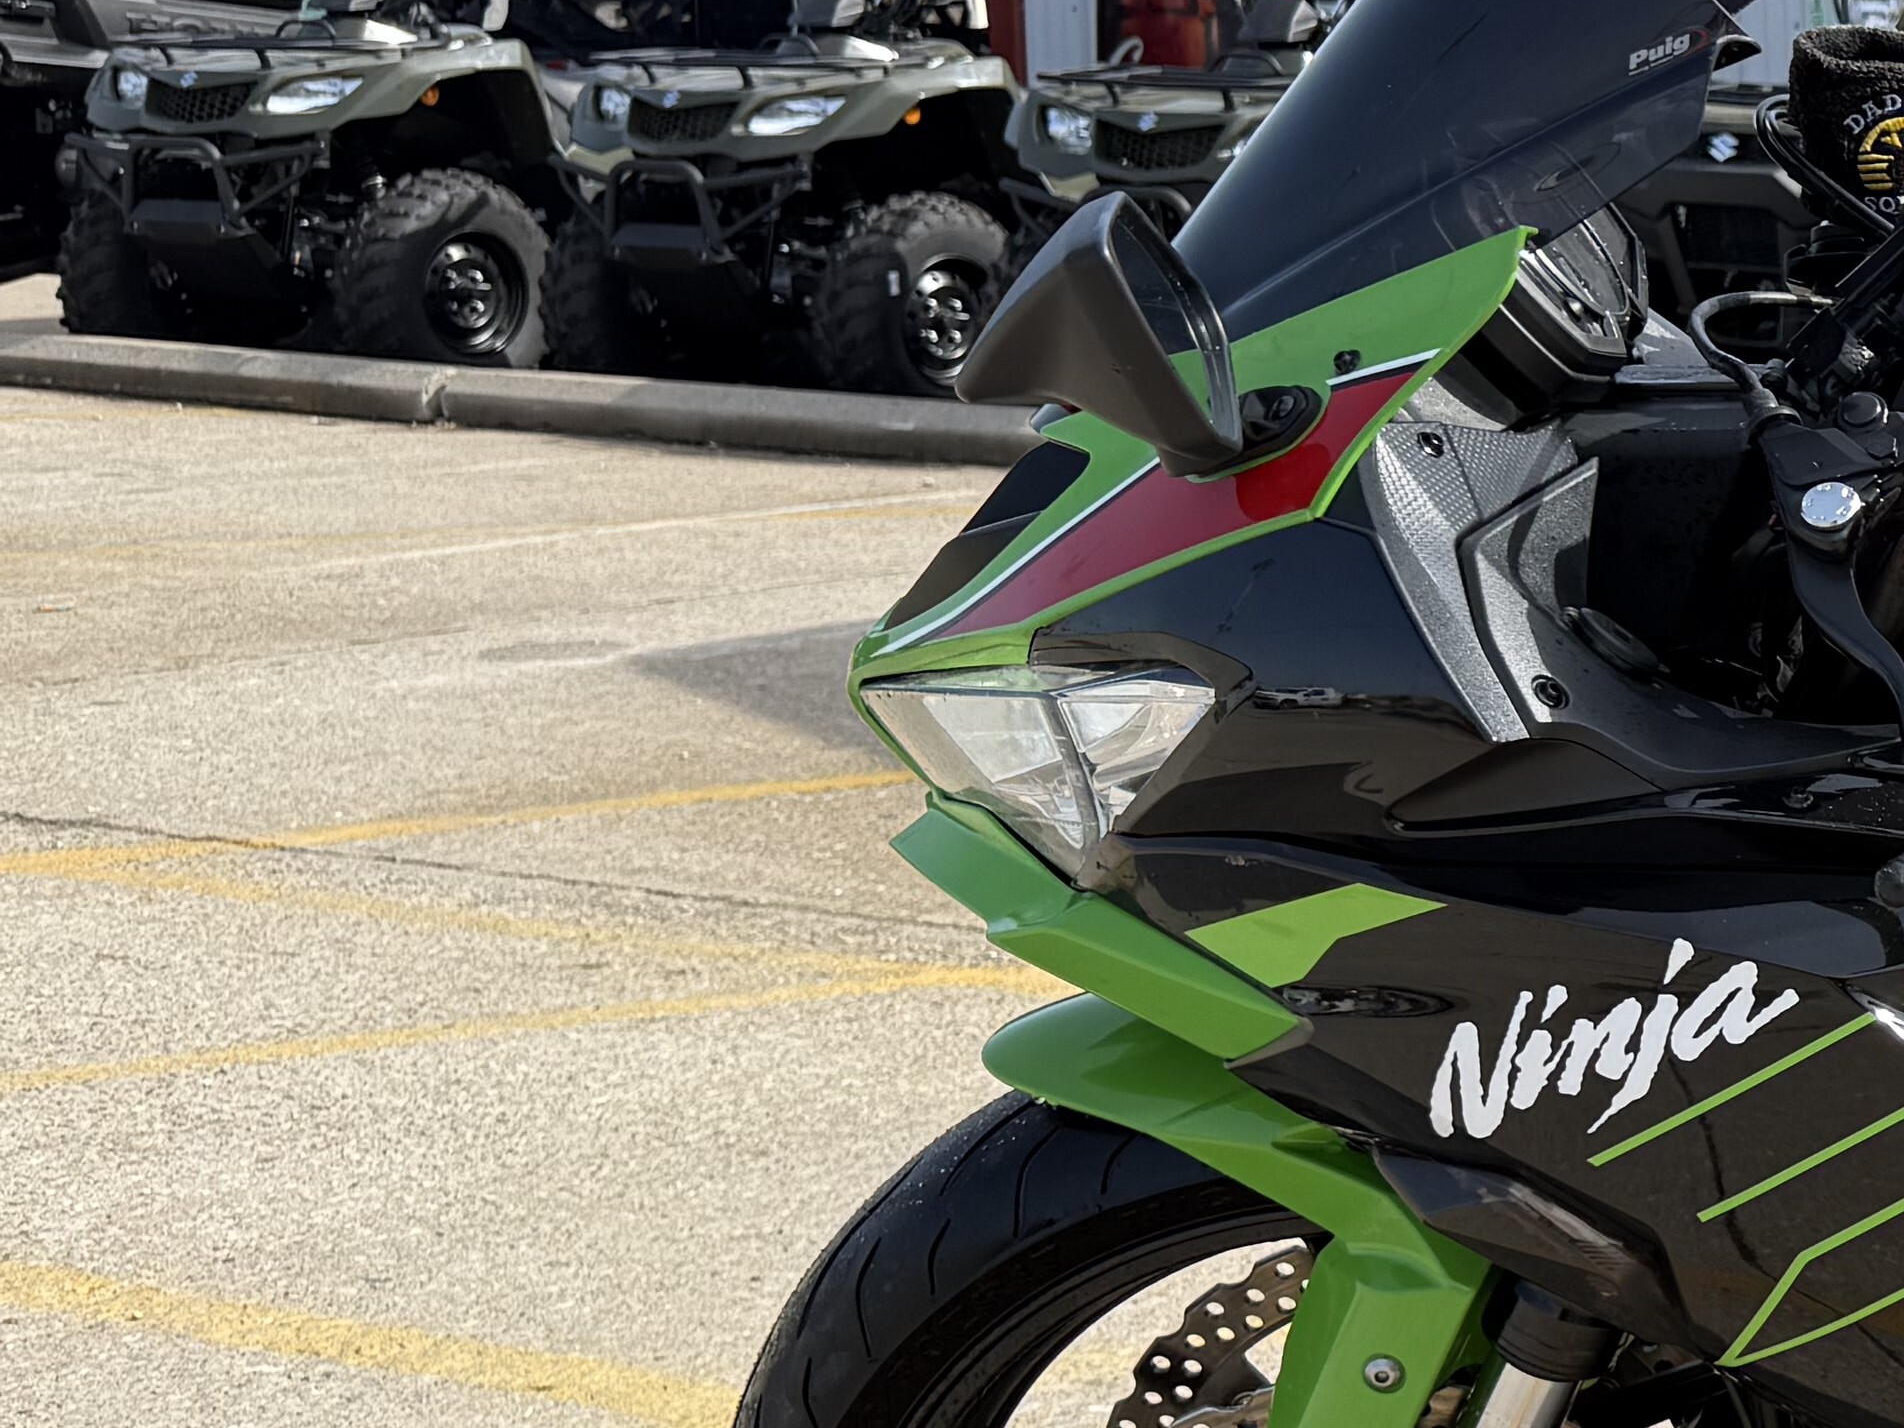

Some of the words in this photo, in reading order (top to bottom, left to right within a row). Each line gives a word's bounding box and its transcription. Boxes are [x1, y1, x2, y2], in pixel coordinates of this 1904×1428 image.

[1629, 33, 1691, 70] Puig
[1843, 93, 1902, 134] DAD
[1429, 937, 1801, 1140] Ninja
